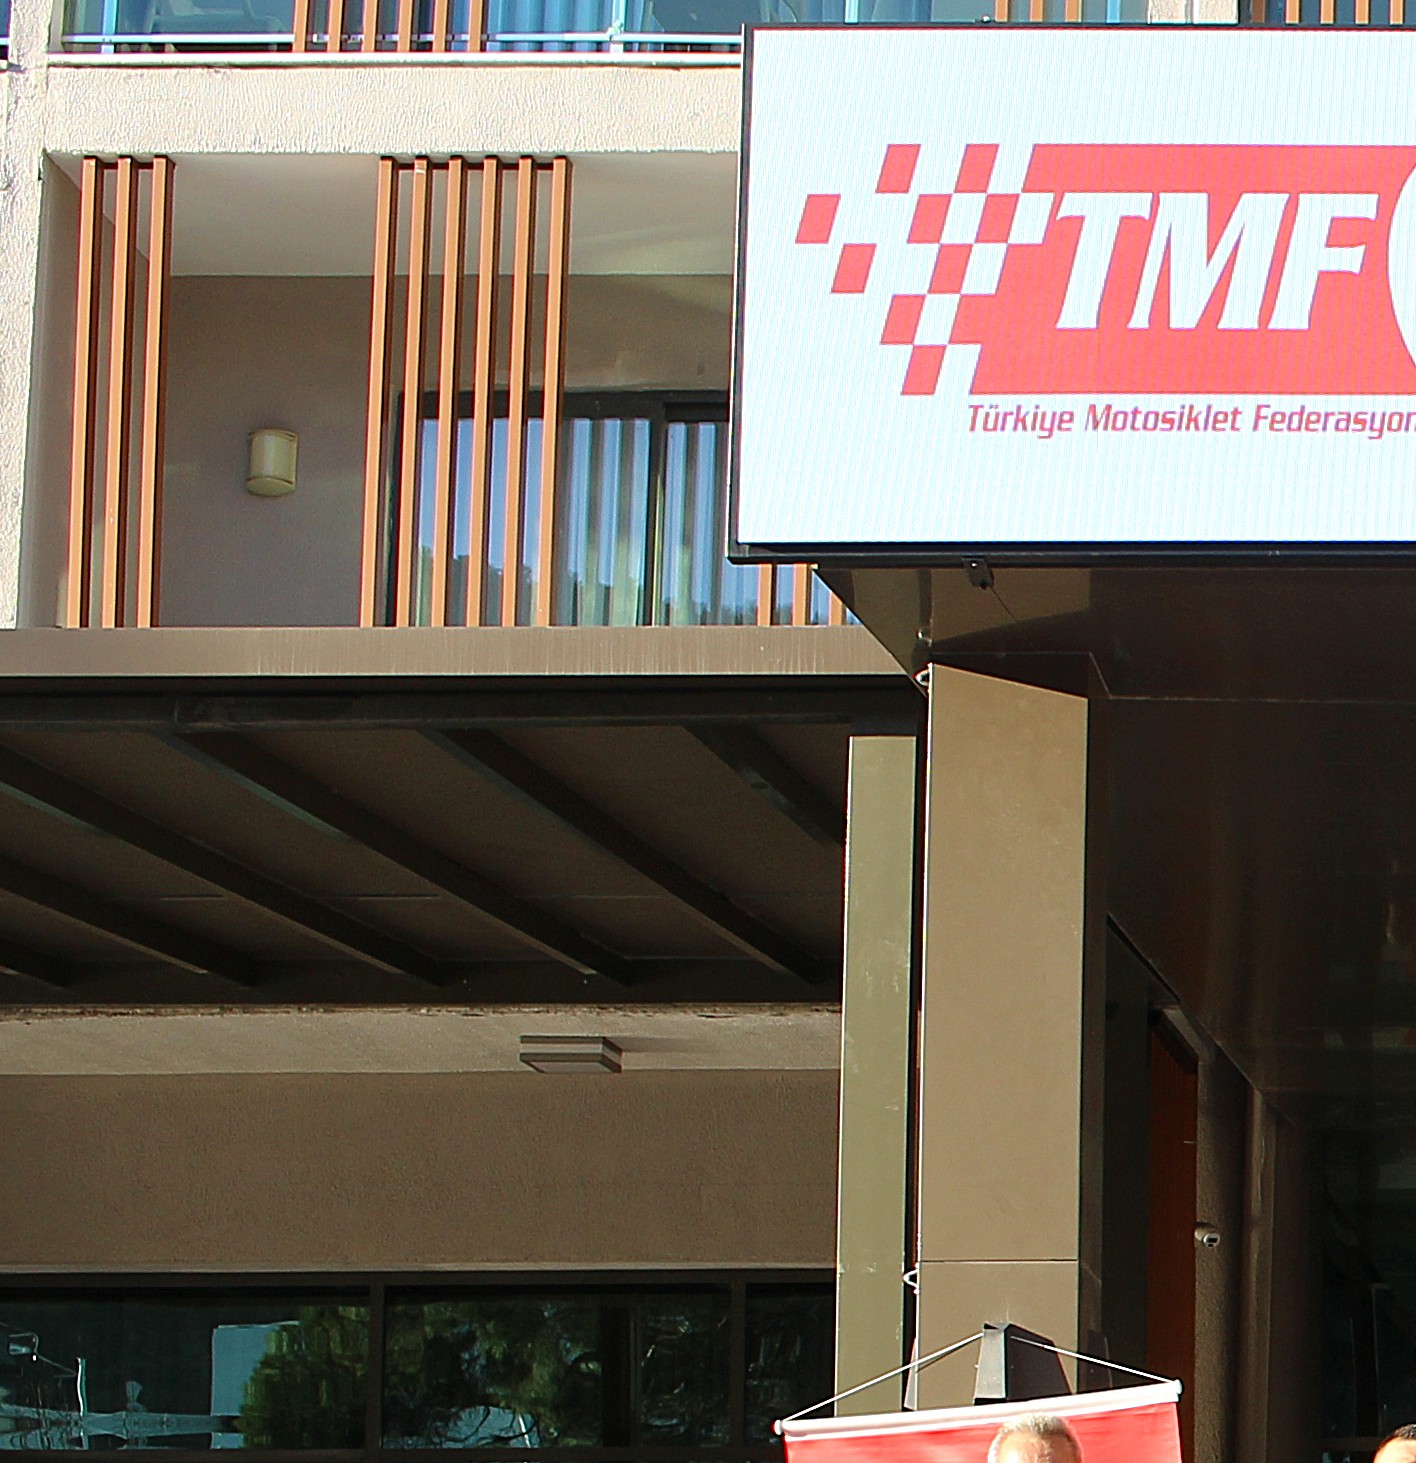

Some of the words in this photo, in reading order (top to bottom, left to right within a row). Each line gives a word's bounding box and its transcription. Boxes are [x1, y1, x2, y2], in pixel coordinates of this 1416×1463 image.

[1055, 193, 1378, 331] TMF
[968, 404, 1075, 440] Türkiye
[1085, 403, 1242, 434] Motosiklet
